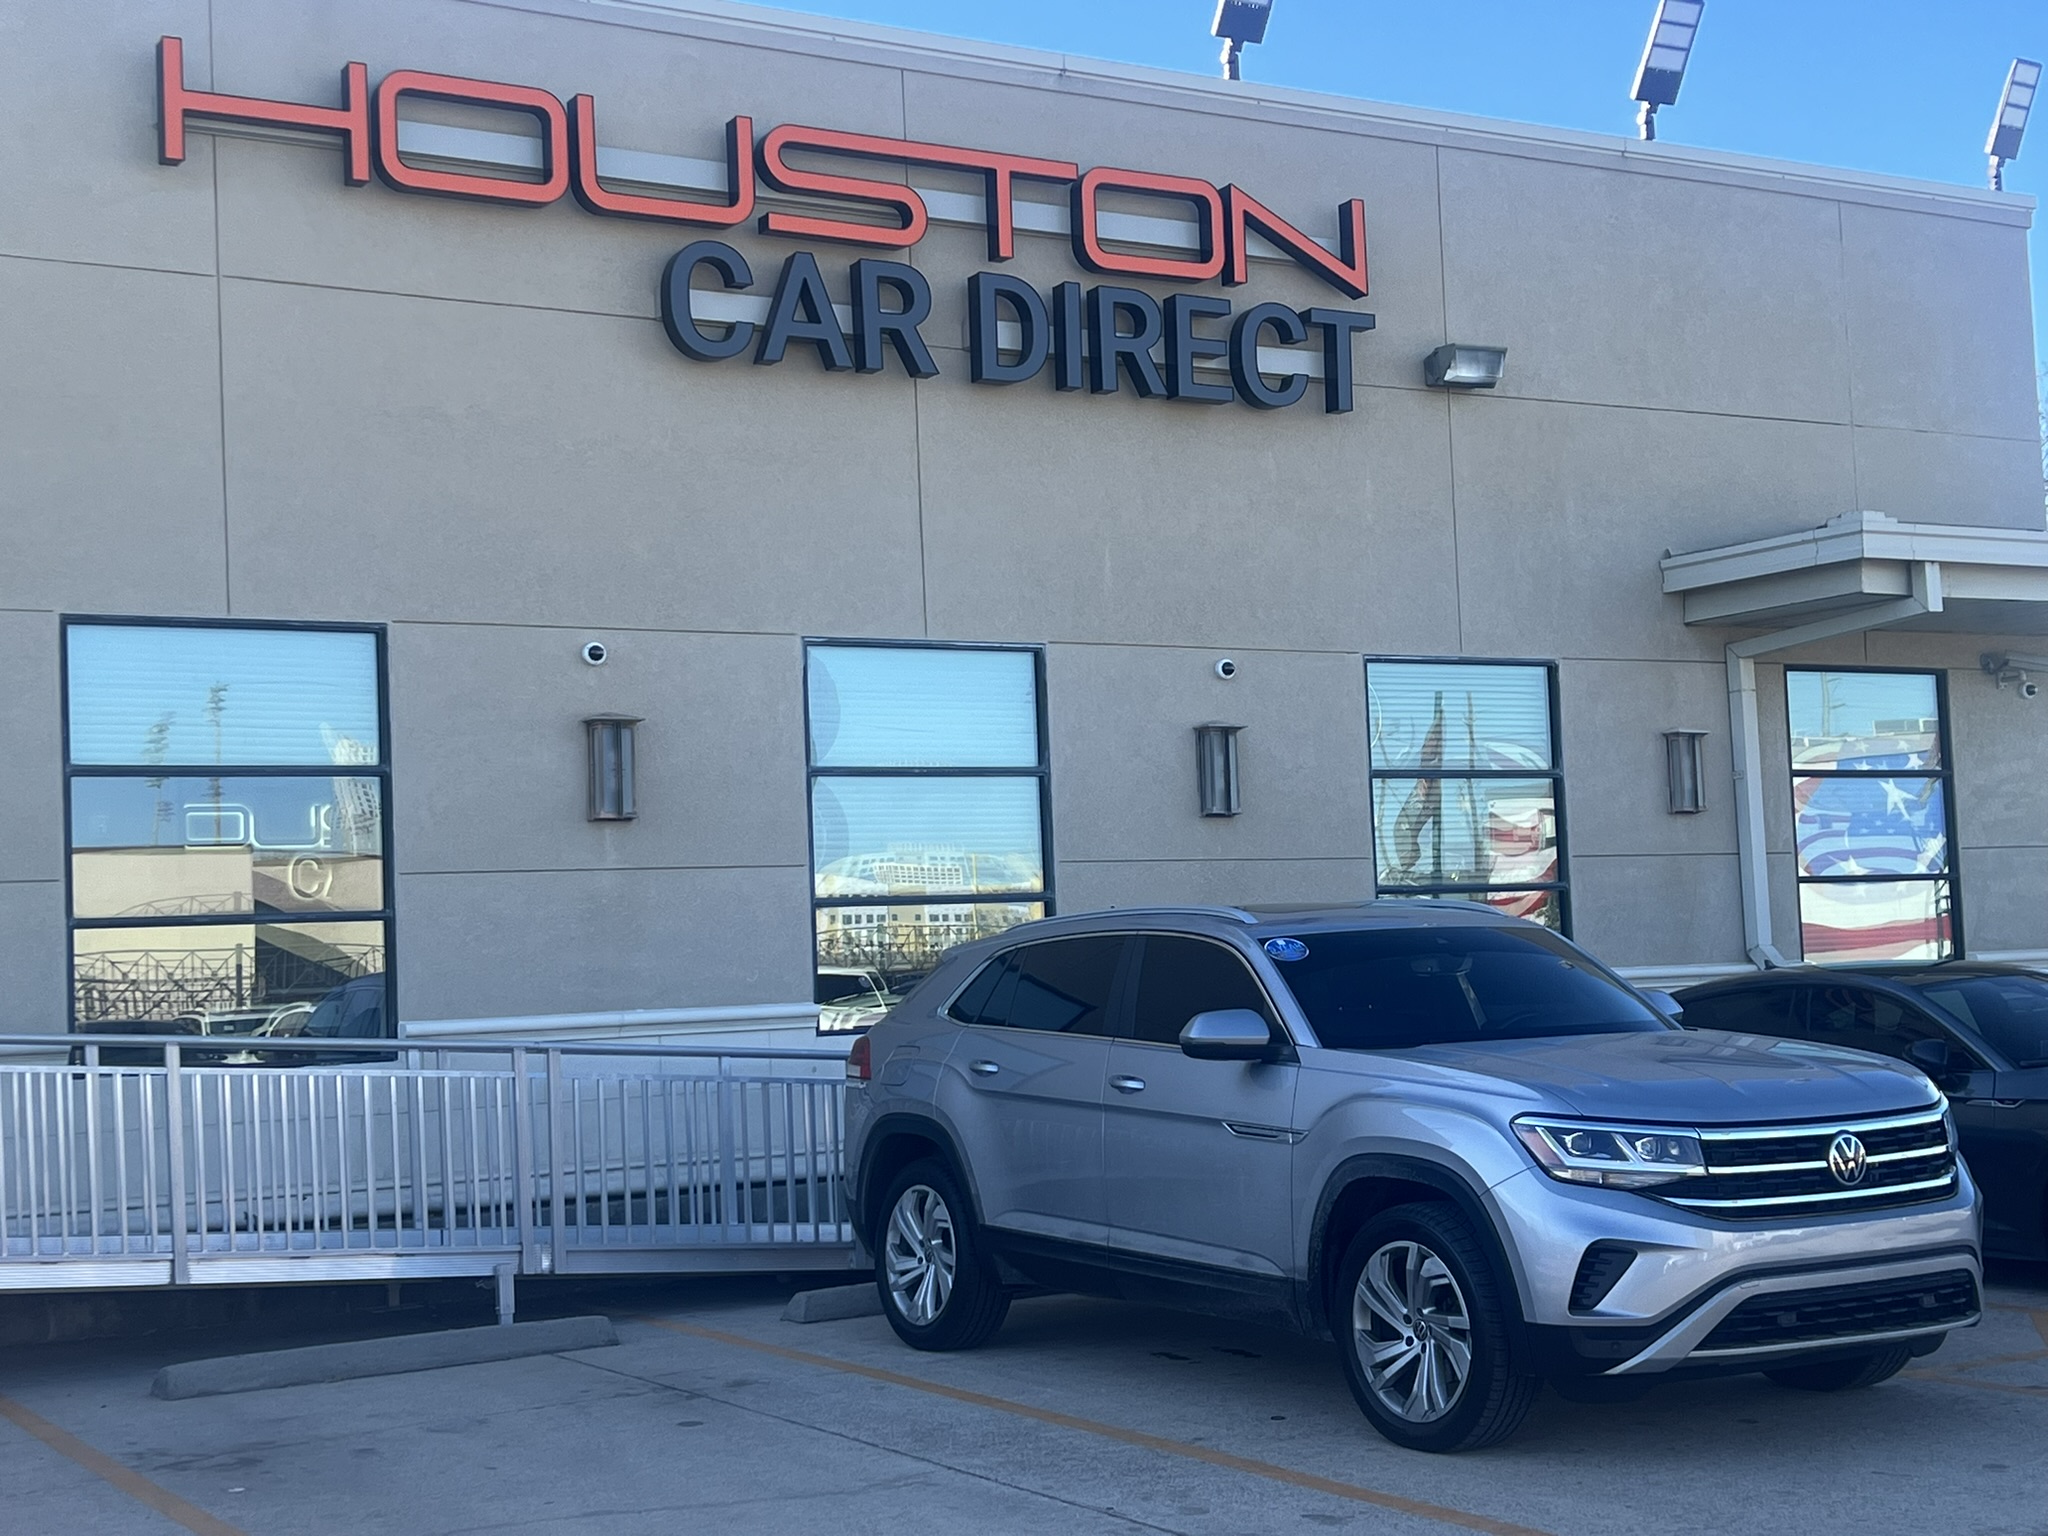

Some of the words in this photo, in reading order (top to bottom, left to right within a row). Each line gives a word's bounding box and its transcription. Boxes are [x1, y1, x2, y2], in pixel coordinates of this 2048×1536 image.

[157, 36, 1369, 299] HOUSTON
[661, 240, 940, 378] CAR
[967, 271, 1376, 415] DIRECT
